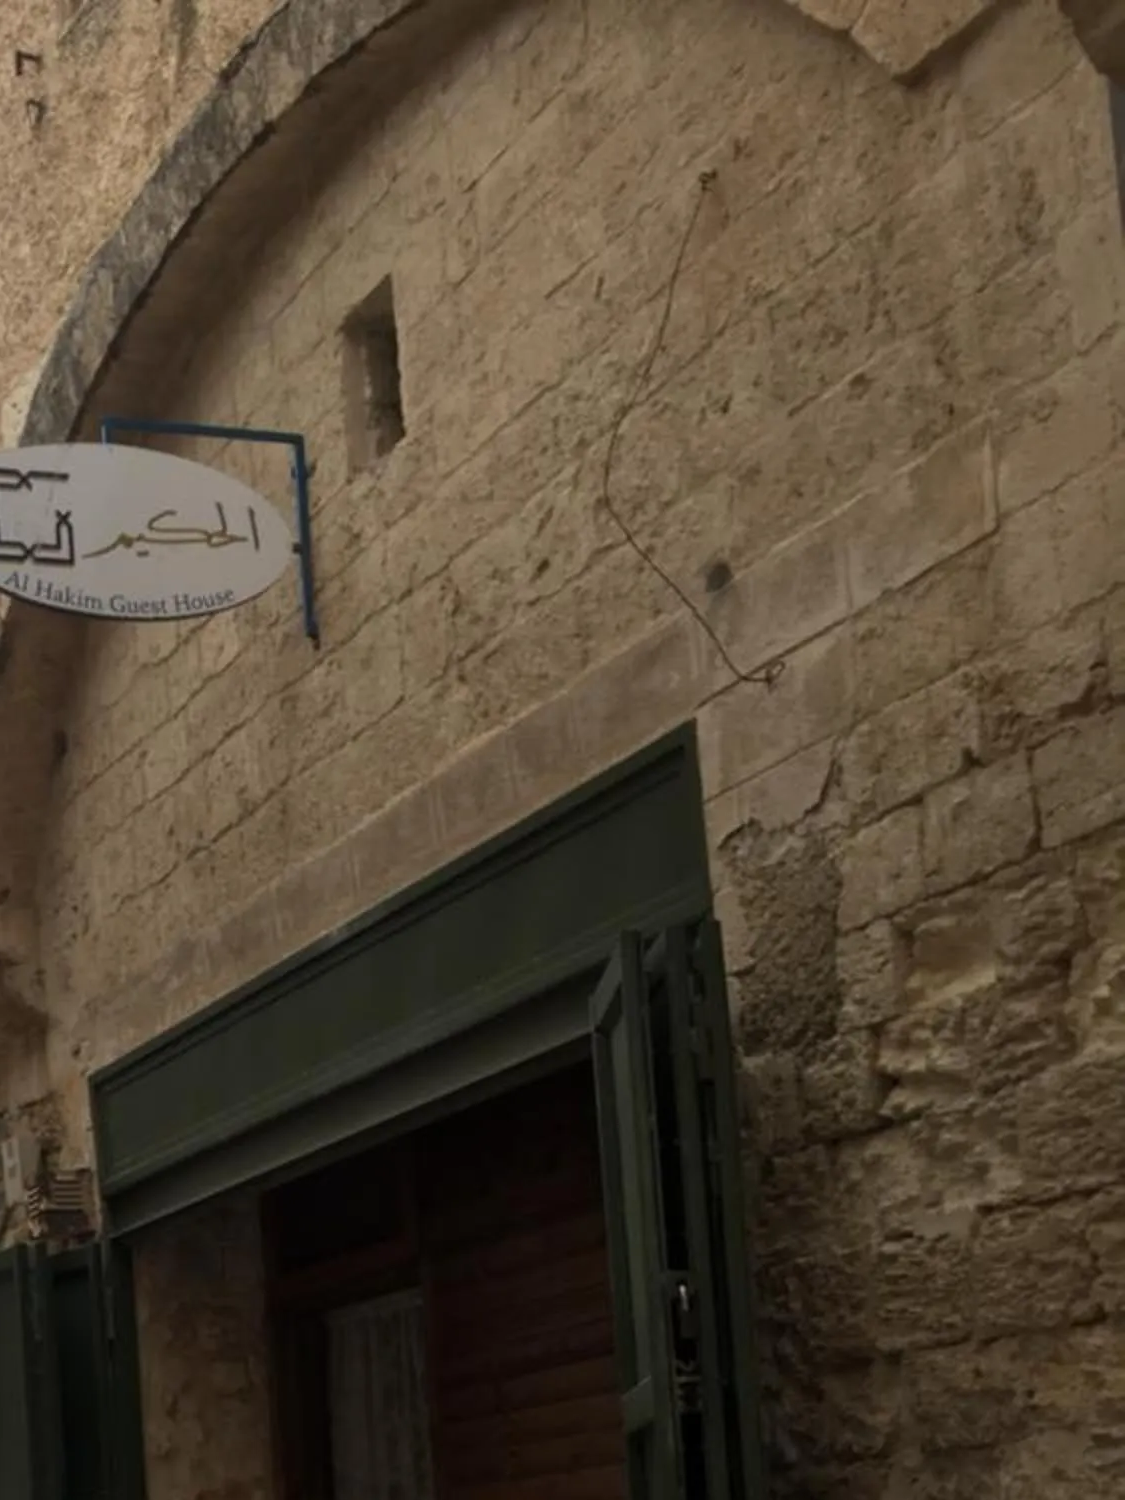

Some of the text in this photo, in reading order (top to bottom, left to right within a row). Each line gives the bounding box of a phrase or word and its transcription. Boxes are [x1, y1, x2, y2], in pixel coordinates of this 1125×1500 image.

[3, 571, 235, 614] Al Hakim Guest House
